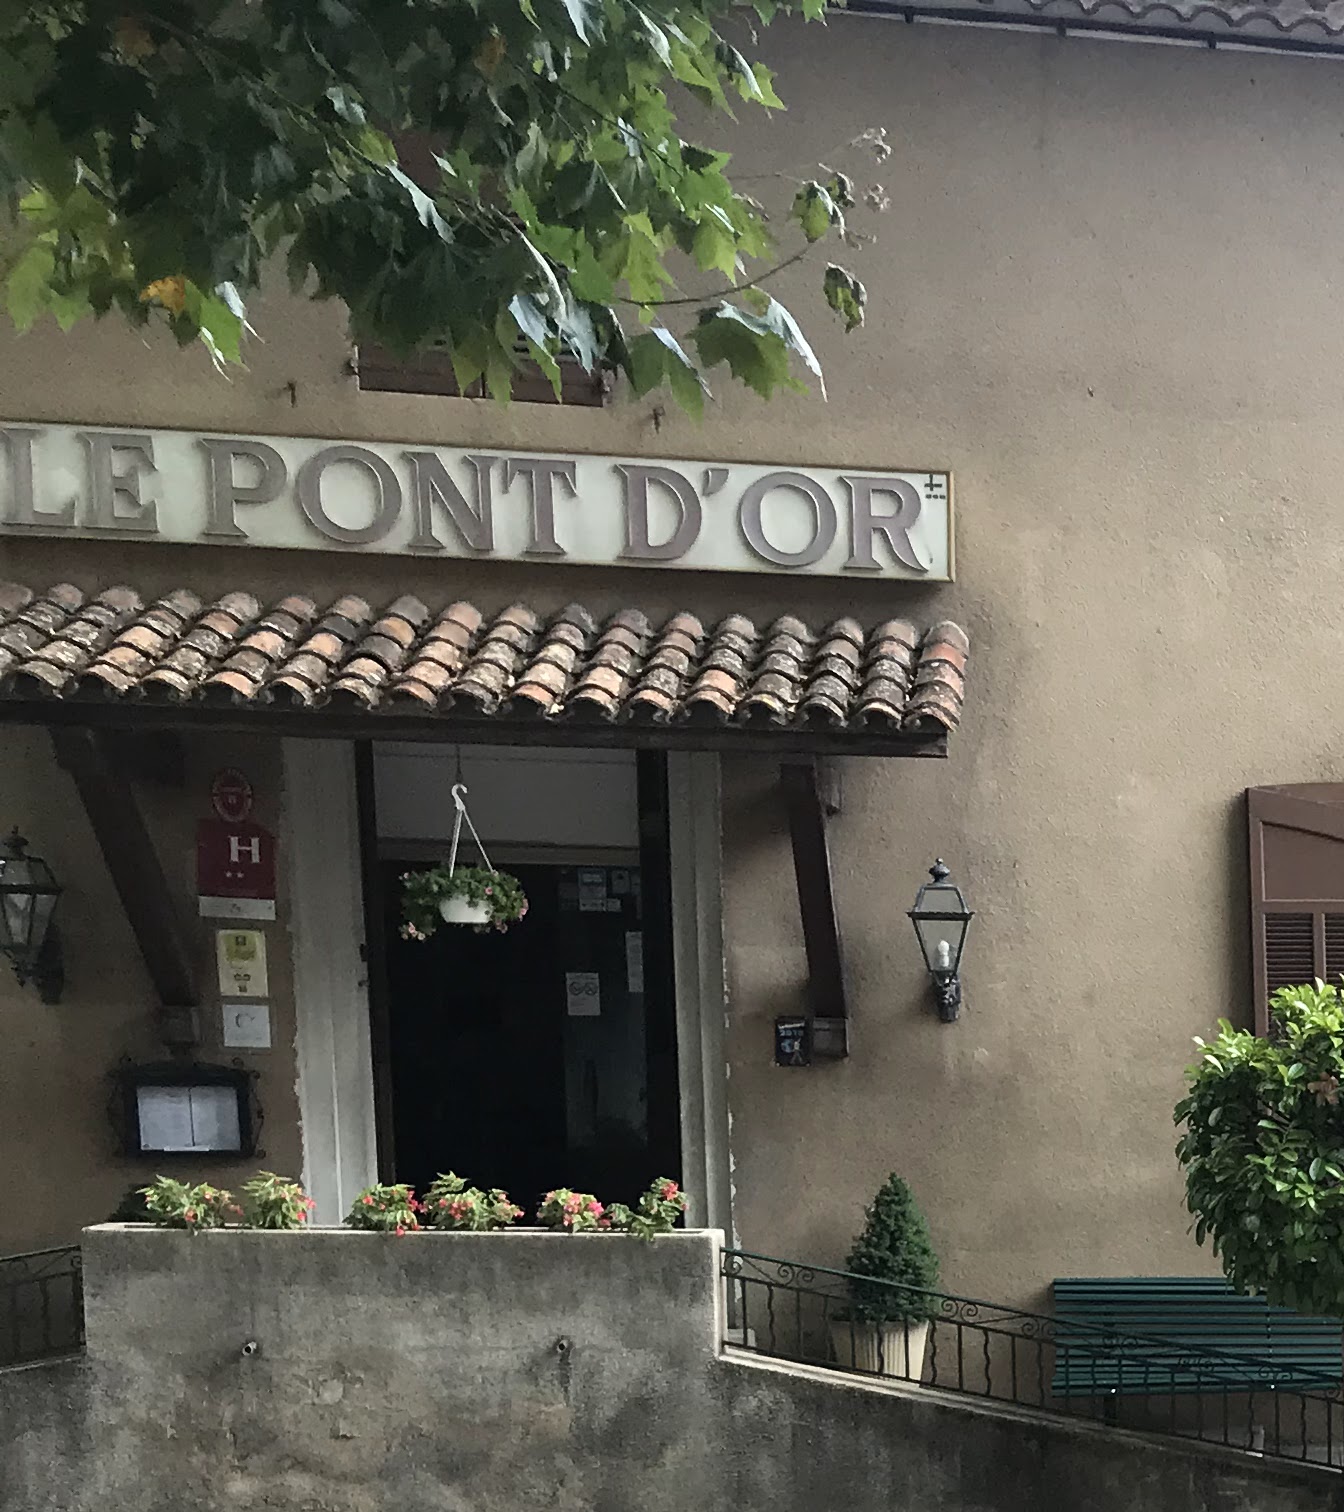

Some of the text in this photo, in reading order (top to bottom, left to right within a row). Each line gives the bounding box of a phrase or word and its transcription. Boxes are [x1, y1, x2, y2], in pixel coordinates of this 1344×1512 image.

[1, 427, 929, 573] LE PONT D'OR
[228, 835, 261, 864] H
